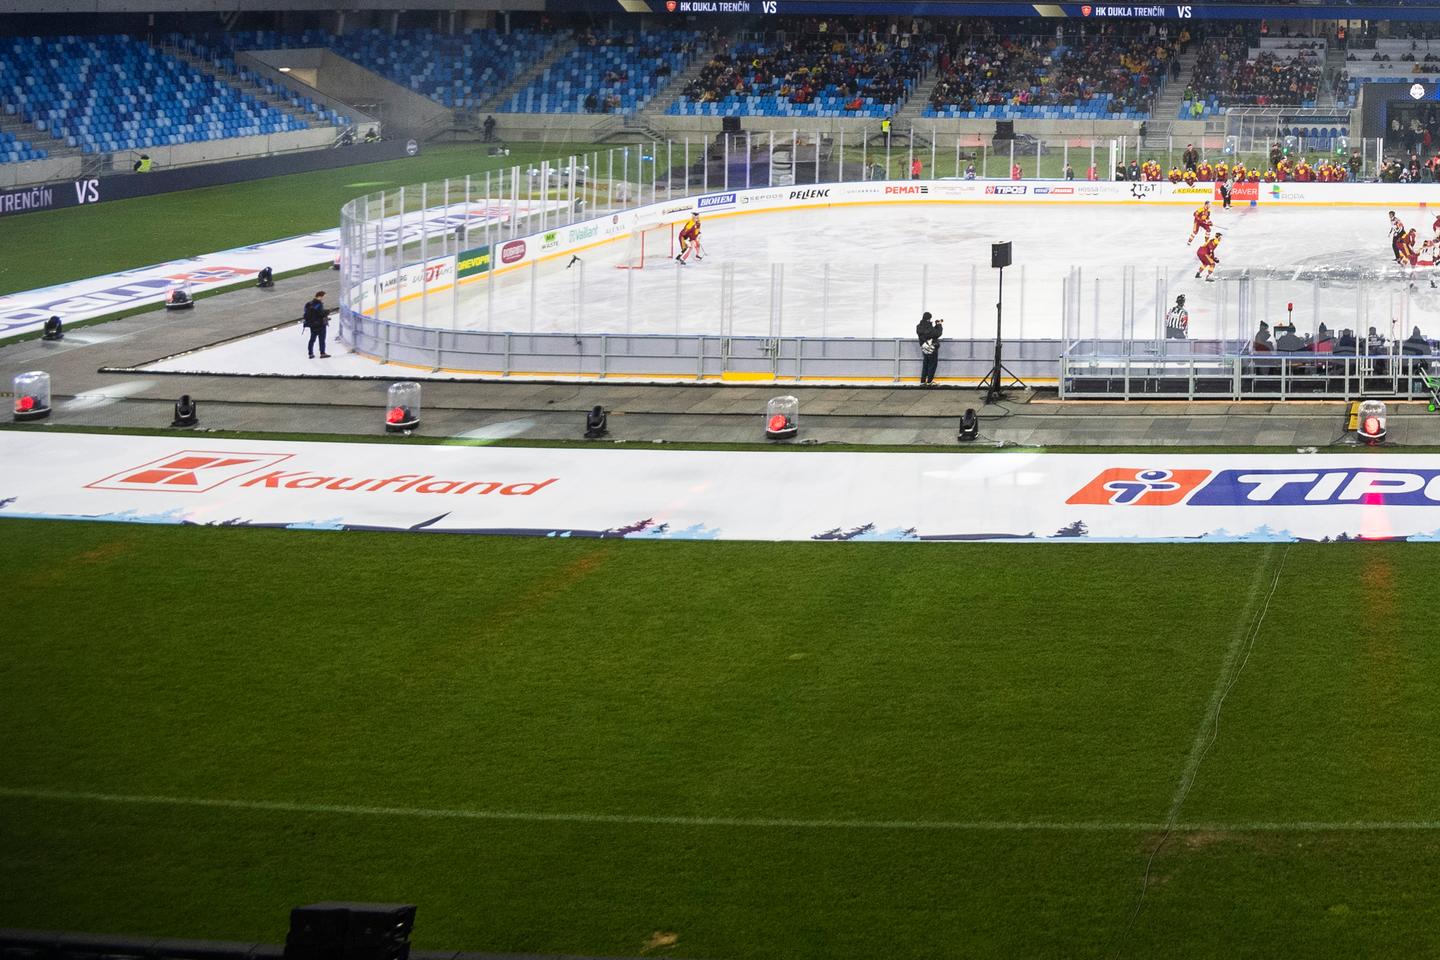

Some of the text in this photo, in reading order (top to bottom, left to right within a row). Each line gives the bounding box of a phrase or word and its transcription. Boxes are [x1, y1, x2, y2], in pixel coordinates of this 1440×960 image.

[680, 1, 777, 13] HK DUKLA TRENČÍN VS
[1095, 6, 1192, 18] HK DUKLA TRENČÍN VS
[0, 179, 99, 212] TRENČÍN VS
[789, 189, 830, 200] PELLENC
[998, 186, 1025, 194] TIPOS
[700, 195, 734, 207] BIOHEM
[240, 470, 559, 496] Kaufland
